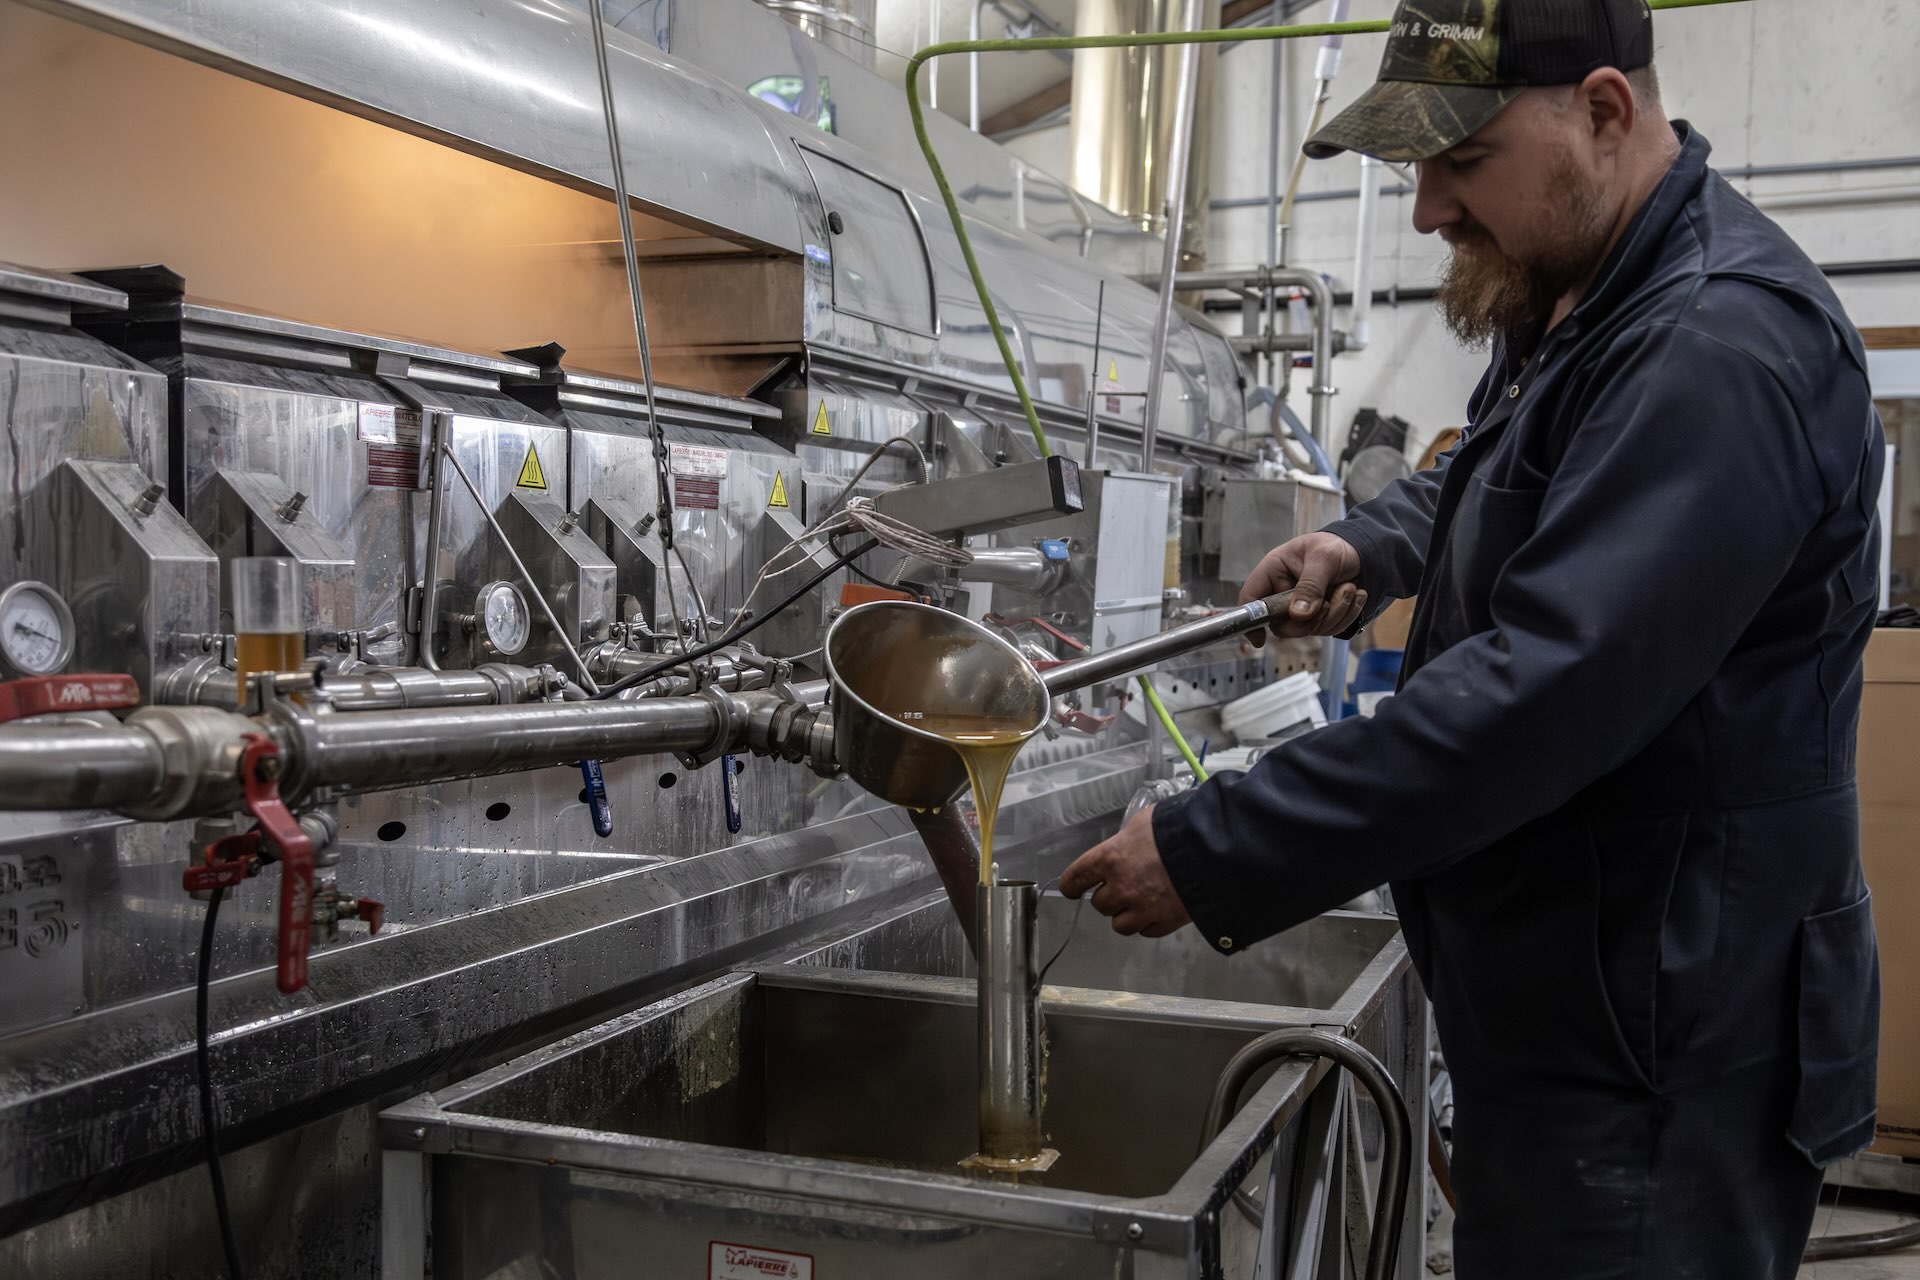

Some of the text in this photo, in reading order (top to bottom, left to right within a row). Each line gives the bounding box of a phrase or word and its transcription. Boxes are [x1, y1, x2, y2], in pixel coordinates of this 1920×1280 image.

[1410, 22, 1422, 36] &
[1427, 23, 1485, 41] GRIMM
[361, 408, 392, 418] LAPIERRE
[730, 1256, 789, 1273] LAPIERRE
